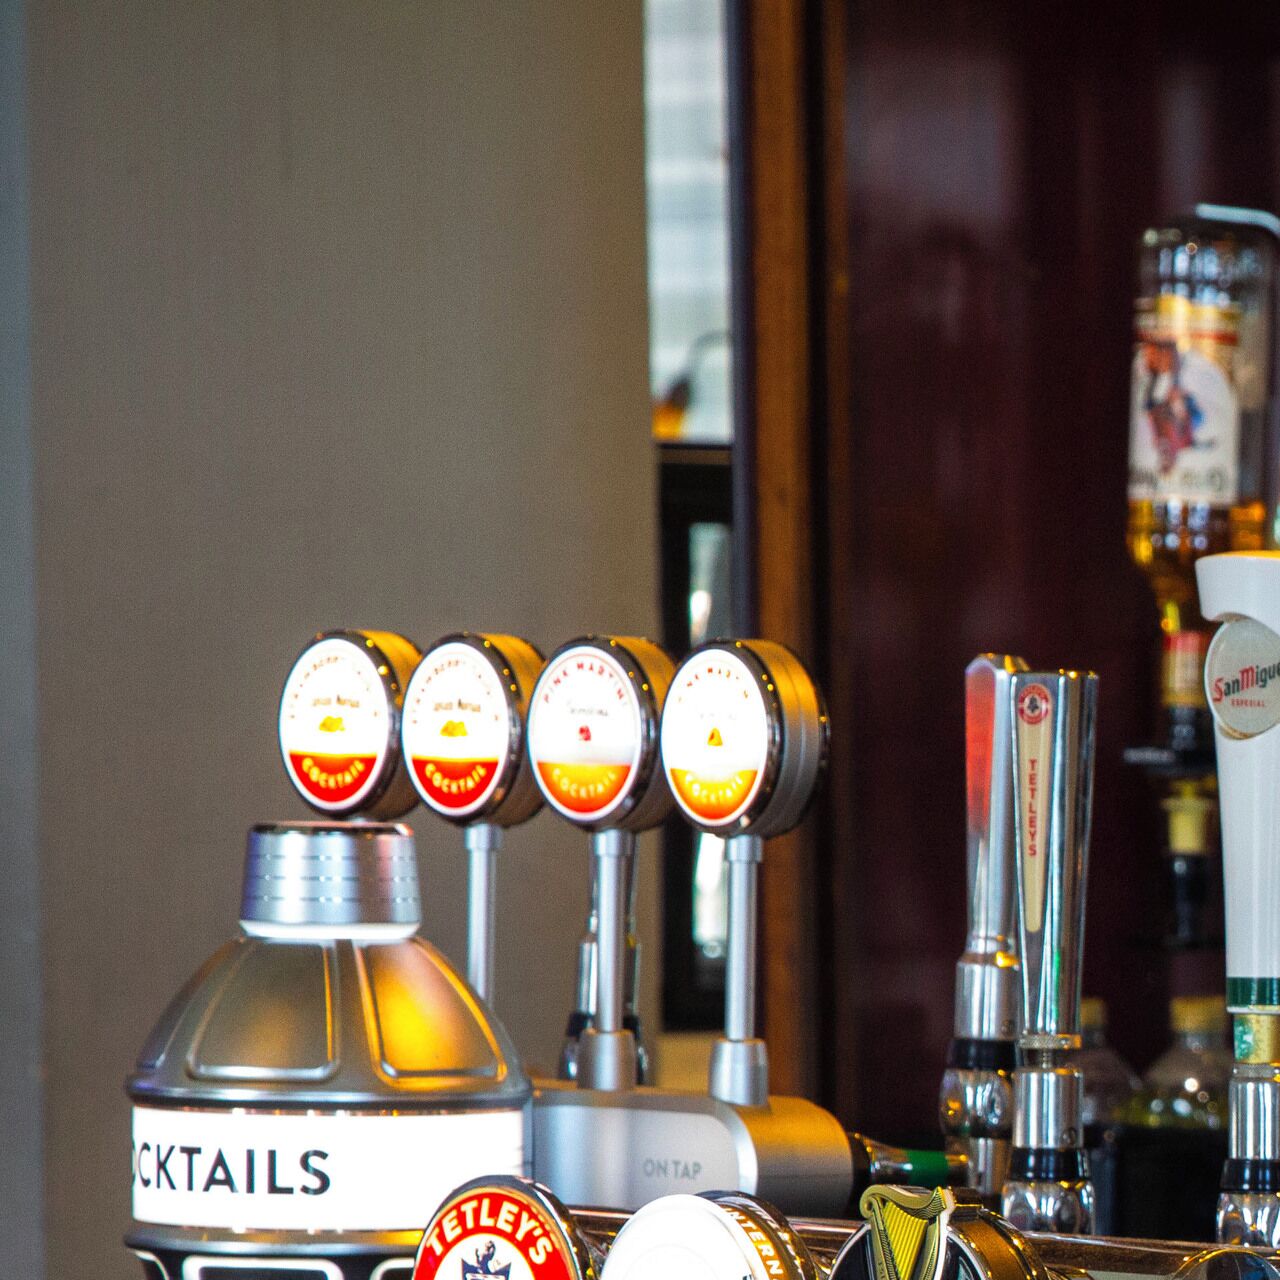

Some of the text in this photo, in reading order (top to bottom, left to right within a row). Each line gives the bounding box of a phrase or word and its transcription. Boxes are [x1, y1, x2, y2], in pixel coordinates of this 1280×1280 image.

[302, 757, 366, 790] COCKTAIL
[423, 762, 488, 795] COCKTAIL
[1027, 758, 1038, 857] TETLEYS
[133, 1141, 332, 1196] CKTAILS
[642, 1157, 703, 1180] ON TAP
[425, 1198, 554, 1265] TETLEY'S
